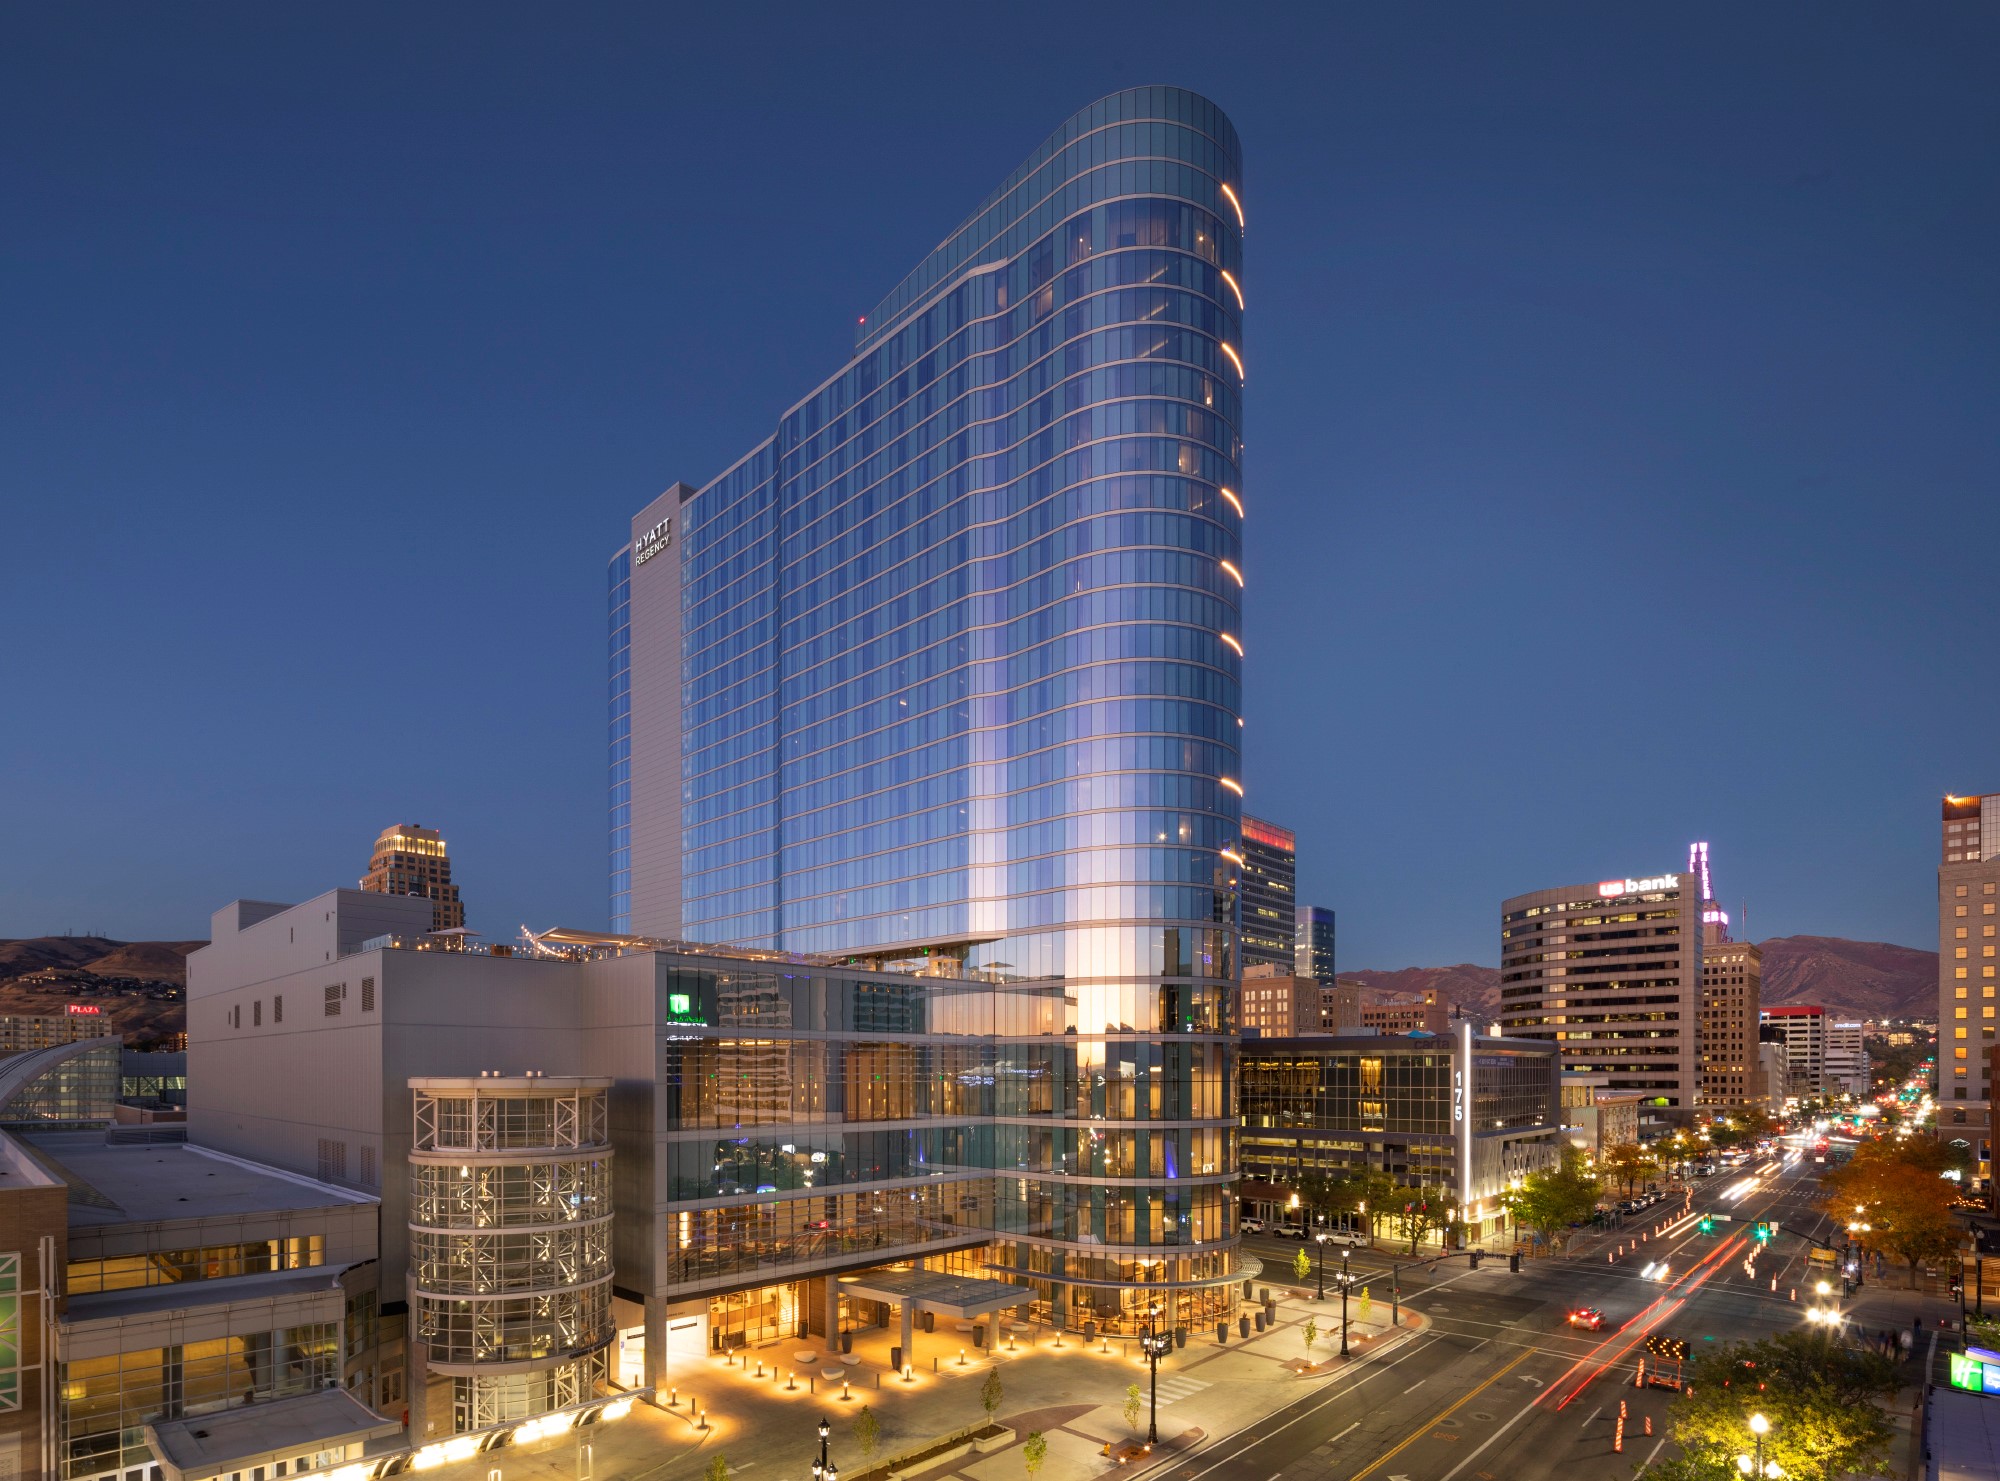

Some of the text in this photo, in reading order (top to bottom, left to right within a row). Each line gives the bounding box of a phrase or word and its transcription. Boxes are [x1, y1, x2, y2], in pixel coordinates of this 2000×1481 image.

[635, 517, 669, 553] HYATT
[635, 535, 669, 566] REGENCY
[70, 1005, 99, 1013] PLAZA
[1415, 1038, 1449, 1049] carta
[1455, 1071, 1463, 1121] 175
